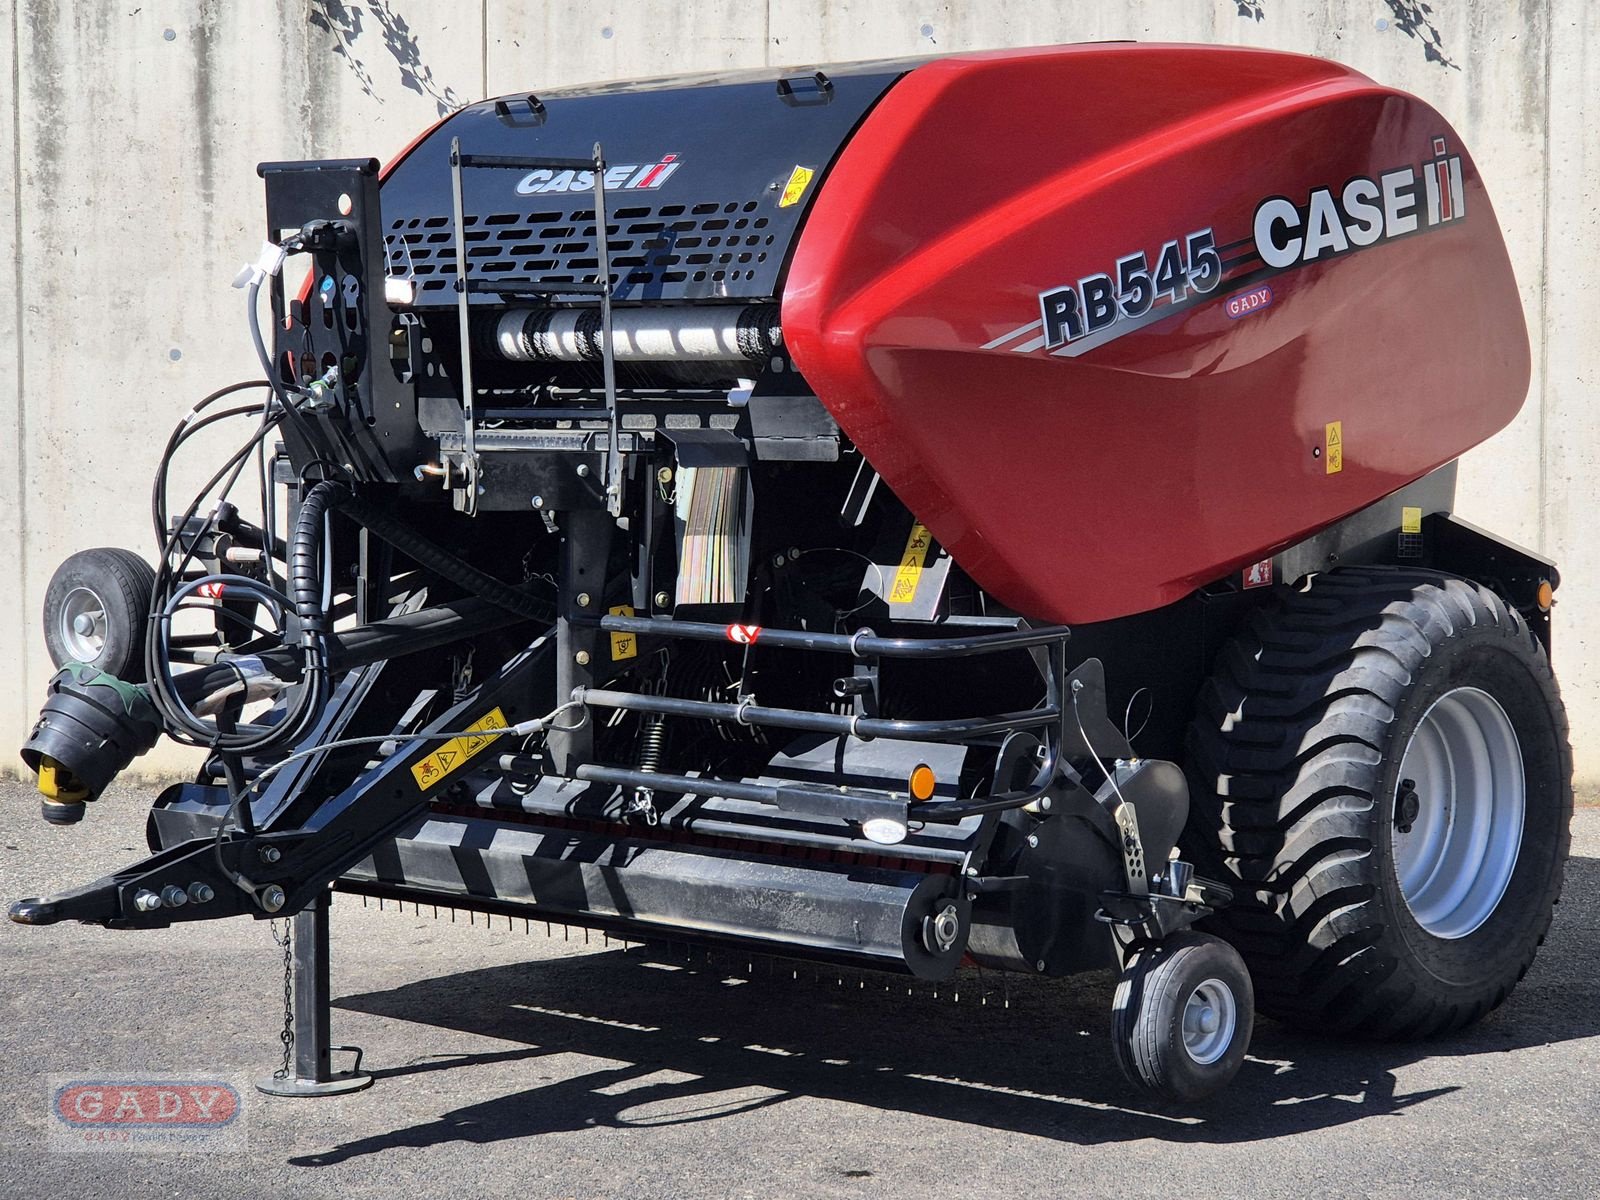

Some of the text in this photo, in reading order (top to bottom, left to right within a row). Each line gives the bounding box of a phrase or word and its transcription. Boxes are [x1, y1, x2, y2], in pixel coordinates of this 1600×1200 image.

[516, 165, 638, 194] CASE
[1254, 168, 1418, 268] CASE
[1038, 227, 1222, 350] RB545
[1230, 289, 1267, 314] GADY
